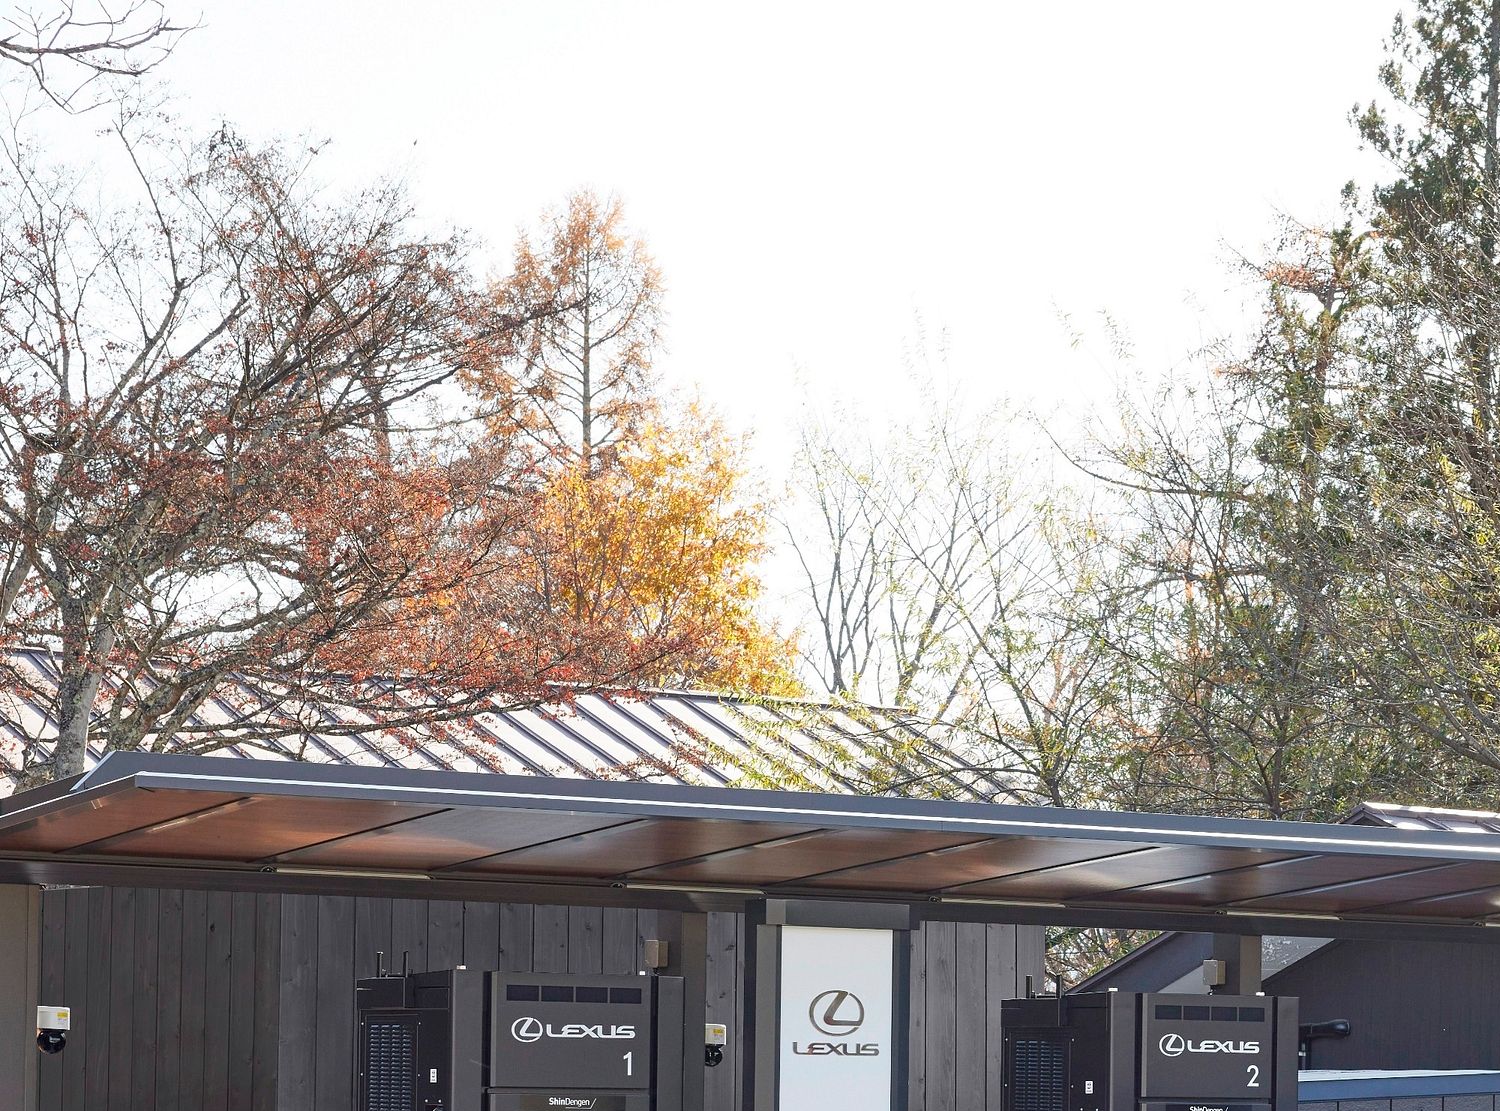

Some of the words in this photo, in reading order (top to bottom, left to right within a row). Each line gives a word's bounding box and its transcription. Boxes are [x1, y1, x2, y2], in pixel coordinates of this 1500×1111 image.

[546, 1023, 636, 1039] LEXUS
[792, 1041, 880, 1057] LEXUS
[1187, 1039, 1260, 1054] LEXUS
[623, 1051, 632, 1076] 1
[1246, 1064, 1260, 1087] 2
[549, 1097, 591, 1108] ShinDengen
